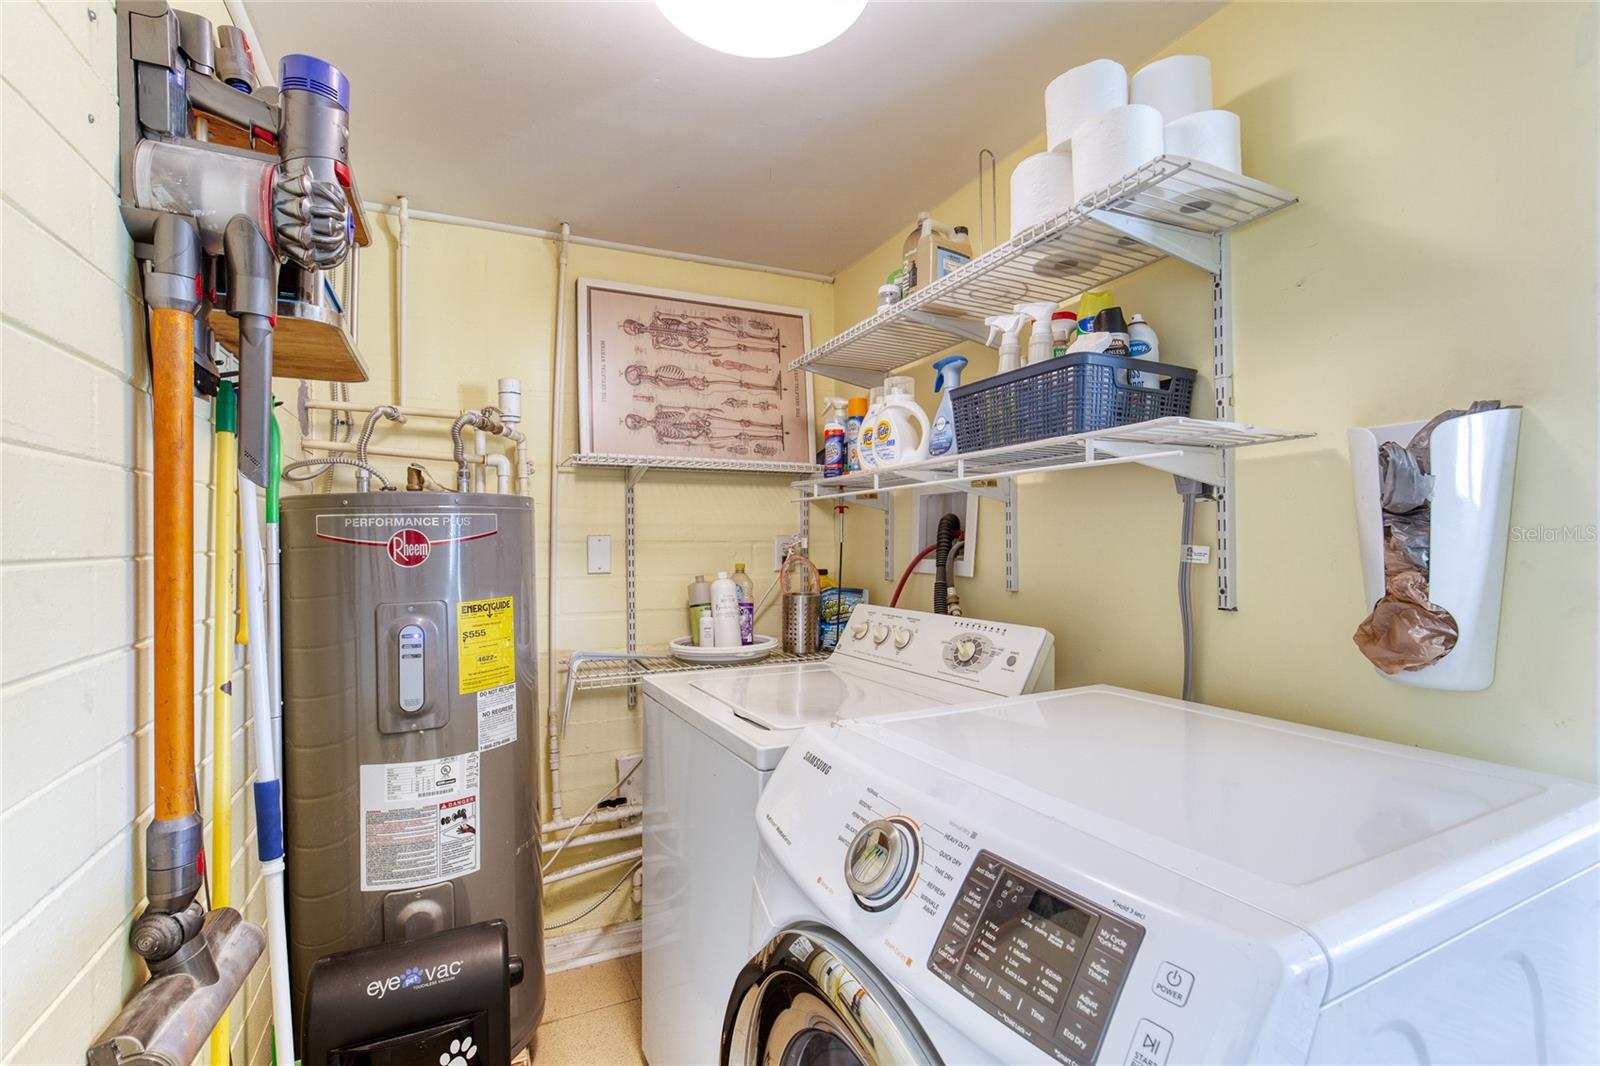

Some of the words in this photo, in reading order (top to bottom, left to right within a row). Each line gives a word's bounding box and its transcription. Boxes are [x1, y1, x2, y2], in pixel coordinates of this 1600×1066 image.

[878, 426, 889, 436] Tide
[344, 517, 440, 527] PERFORMANCE
[442, 516, 471, 526] PLUS
[393, 530, 428, 562] Rheem
[462, 629, 486, 640] $555
[498, 684, 515, 692] RETURN
[803, 752, 832, 776] SAMSUNG
[448, 796, 474, 807] DANGER
[944, 833, 958, 846] HEAVY
[958, 840, 970, 852] DUTY
[939, 850, 952, 862] QUICK
[952, 857, 962, 868] DRY
[934, 865, 944, 876] TIME
[944, 871, 954, 882] DRY
[926, 881, 946, 898] REFRESH
[920, 894, 940, 910] WRINKLE
[922, 904, 936, 917] AWAY
[989, 921, 1000, 932] Very
[985, 931, 996, 941] More
[1100, 929, 1110, 940] My
[1110, 934, 1127, 948] Cycle
[981, 940, 997, 953] Normal
[1017, 938, 1028, 950] High
[977, 948, 990, 961] Damp
[1013, 948, 1032, 964] Medium
[1008, 957, 1019, 968] Low
[1090, 961, 1110, 977] Adjust
[366, 976, 401, 999] eye
[424, 960, 461, 981] vac
[965, 963, 973, 974] Dry
[972, 969, 987, 982] Level
[1005, 967, 1018, 979] Extra
[1017, 975, 1028, 986] Low
[1045, 968, 1063, 983] 60min
[1087, 968, 1102, 980] Time
[1041, 978, 1059, 993] 40min
[1156, 982, 1183, 1001] POWER
[1037, 988, 1055, 1004] 20min
[1079, 994, 1098, 1010] Adjust
[1031, 1008, 1045, 1023] Time
[1076, 1001, 1091, 1015] Time
[1063, 1028, 1075, 1041] Eco
[1075, 1035, 1087, 1050] Dry
